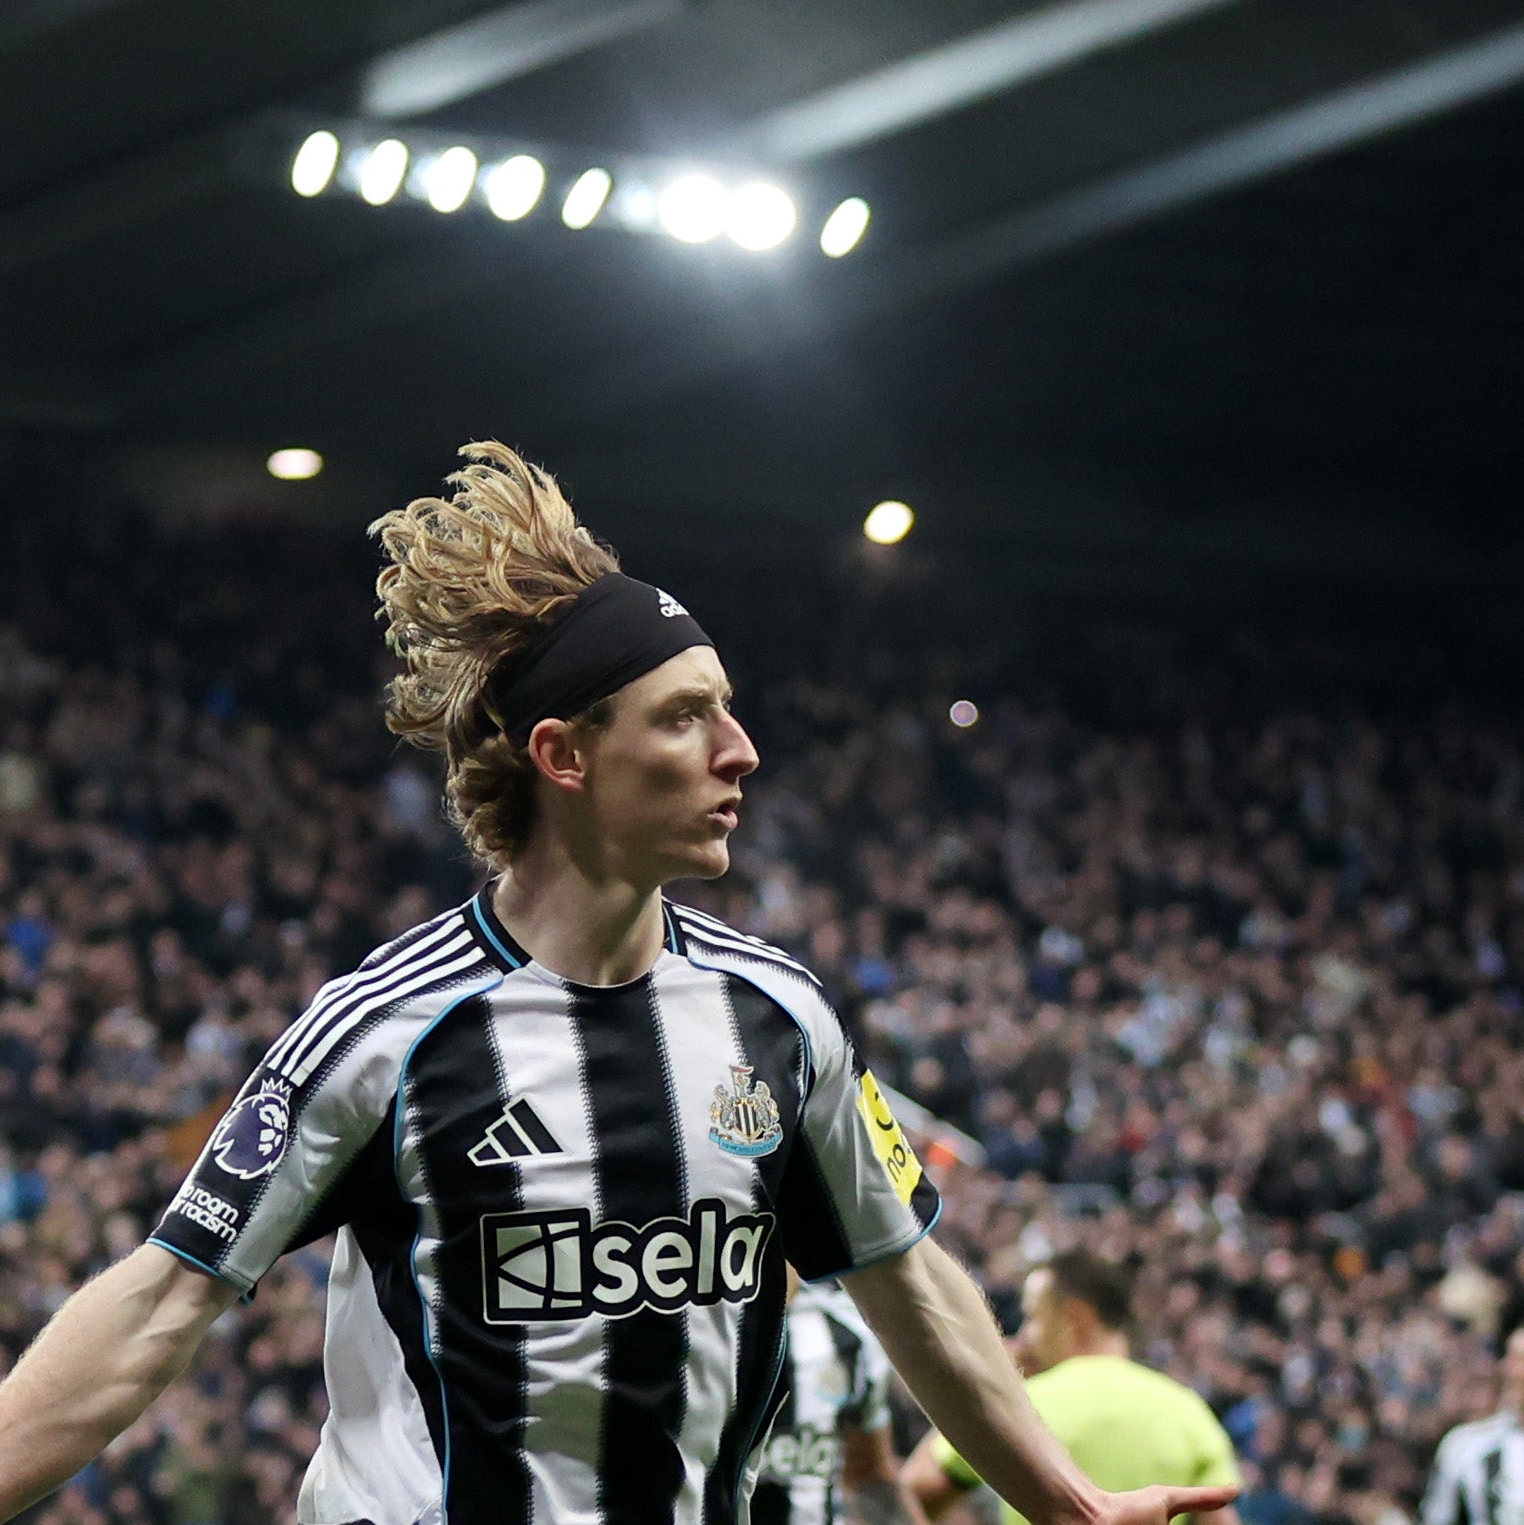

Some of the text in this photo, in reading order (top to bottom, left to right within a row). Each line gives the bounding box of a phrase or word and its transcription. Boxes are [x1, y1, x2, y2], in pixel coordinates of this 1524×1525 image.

[180, 1201, 237, 1243] racism
[190, 1188, 239, 1225] room
[591, 1210, 765, 1304] sela
[763, 1429, 838, 1475] ela
